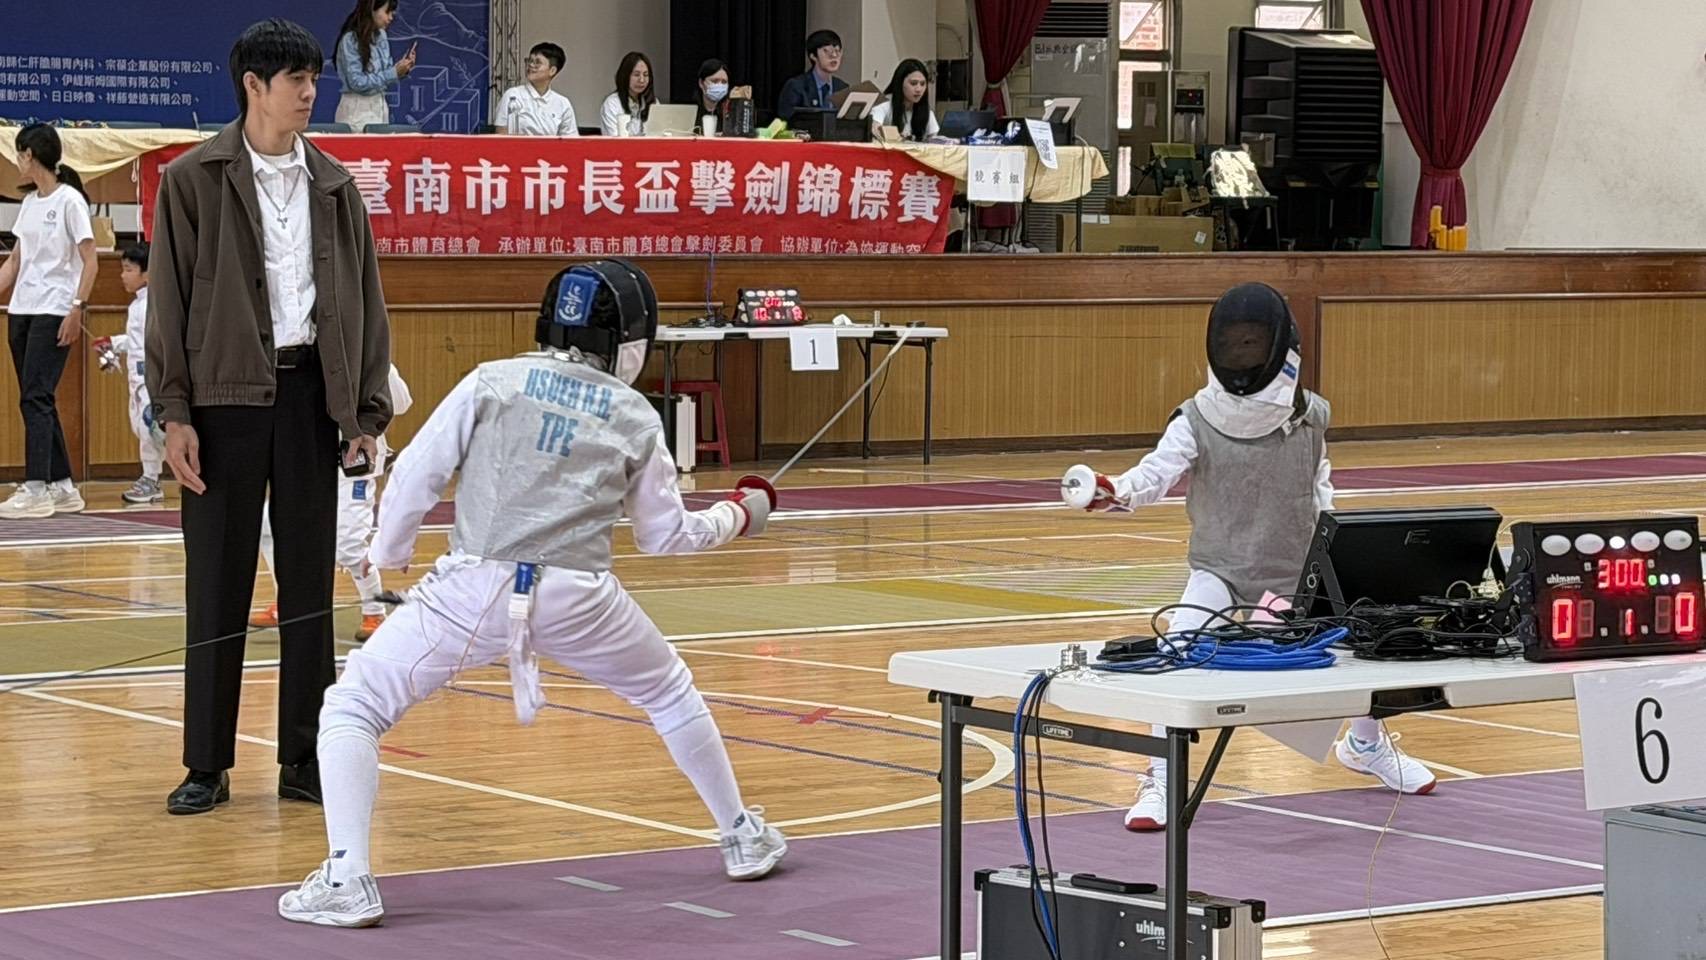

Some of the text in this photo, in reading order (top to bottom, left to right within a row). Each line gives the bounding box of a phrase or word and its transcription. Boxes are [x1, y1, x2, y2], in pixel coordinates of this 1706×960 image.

[809, 338, 819, 365] 1
[536, 411, 578, 457] TPE
[1546, 573, 1581, 584] uhlmann
[1635, 696, 1671, 785] 6
[1136, 919, 1166, 936] uhlm
